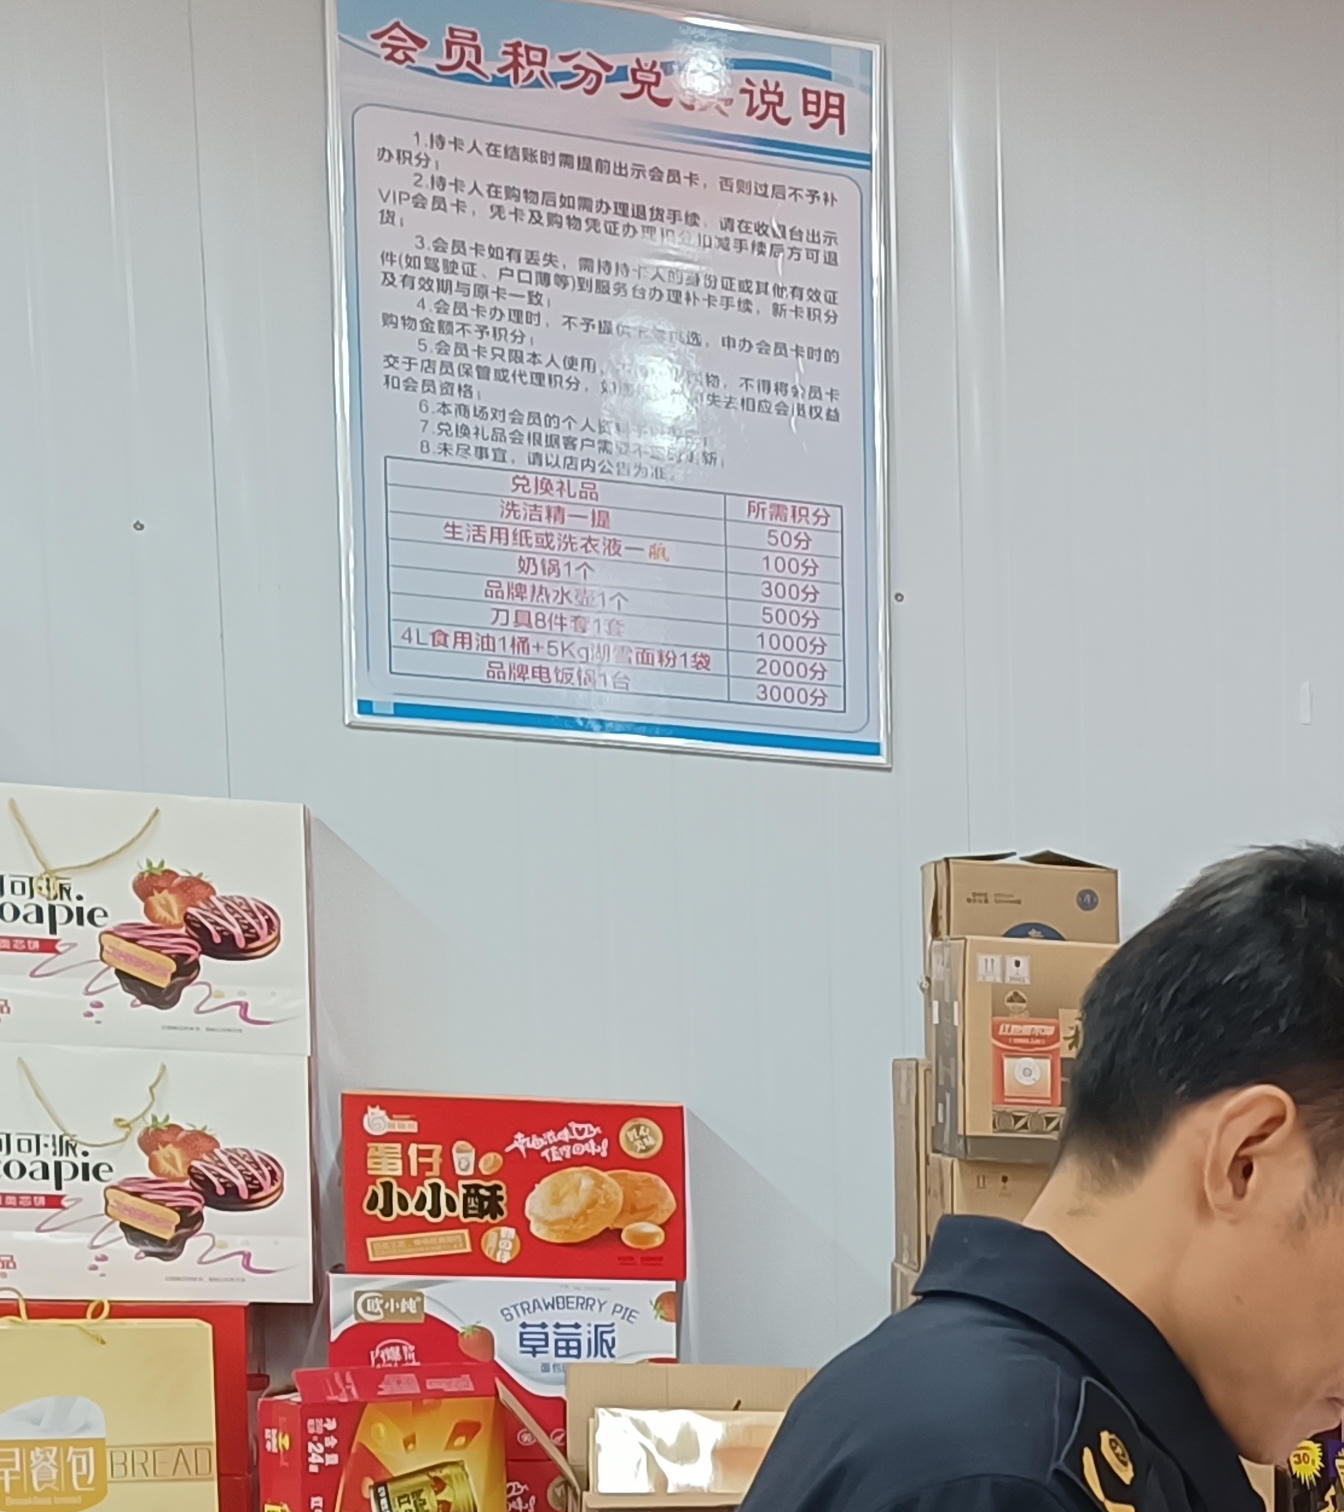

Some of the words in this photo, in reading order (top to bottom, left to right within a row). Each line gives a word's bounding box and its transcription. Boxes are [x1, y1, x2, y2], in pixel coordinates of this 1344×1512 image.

[369, 19, 847, 136] 会员积分兑说明
[511, 475, 599, 501] 兑换礼品
[746, 500, 831, 527] 所需积分
[499, 500, 610, 529] 洗洁精一提
[766, 529, 812, 550] 50分
[517, 555, 595, 580] 奶锅1个
[760, 580, 820, 603] 300分
[760, 555, 820, 577] 100分
[760, 607, 821, 629] 500分
[755, 631, 828, 656] 1000分
[486, 659, 631, 692] 品牌电饭锅1台
[755, 684, 829, 708] 3000分
[755, 658, 828, 682] 2000分
[0, 1159, 114, 1191] oapie
[366, 1142, 443, 1177] 蛋仔
[365, 1178, 505, 1220] 小小酥
[500, 1295, 607, 1324] STRAWBERRY
[610, 1303, 640, 1325] PIE
[519, 1322, 616, 1360] 草莓派
[0, 1446, 95, 1492] 早餐包
[108, 1447, 213, 1479] BREAD
